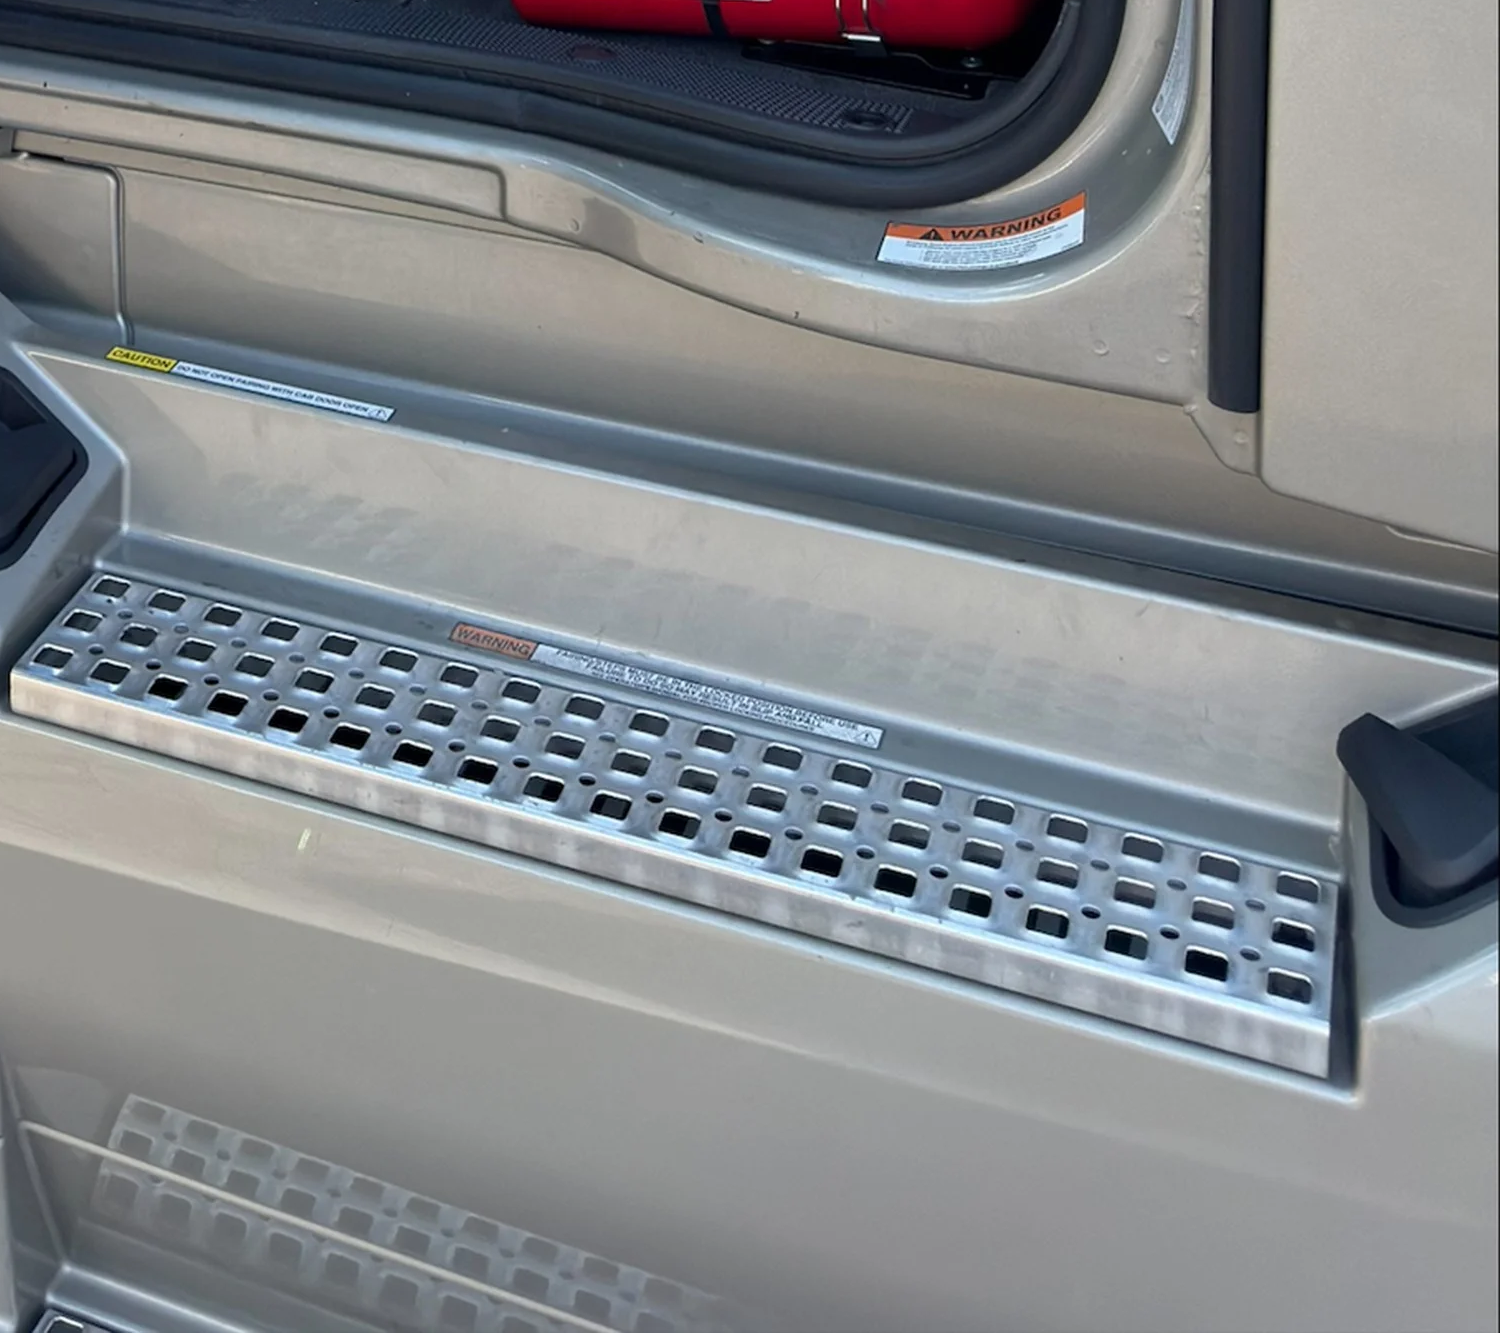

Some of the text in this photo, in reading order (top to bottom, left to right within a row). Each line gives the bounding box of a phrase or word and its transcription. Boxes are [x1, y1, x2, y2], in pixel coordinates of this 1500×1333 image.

[950, 207, 1062, 241] WARNING
[112, 348, 171, 369] CAUTION
[177, 364, 190, 373] DO
[191, 367, 209, 377] NOT
[210, 372, 235, 383] OPEN
[271, 386, 293, 396] WITH
[294, 391, 314, 401] CAB
[315, 396, 341, 408] DOOR
[342, 402, 369, 414] OPEN
[456, 627, 532, 656] WARNING
